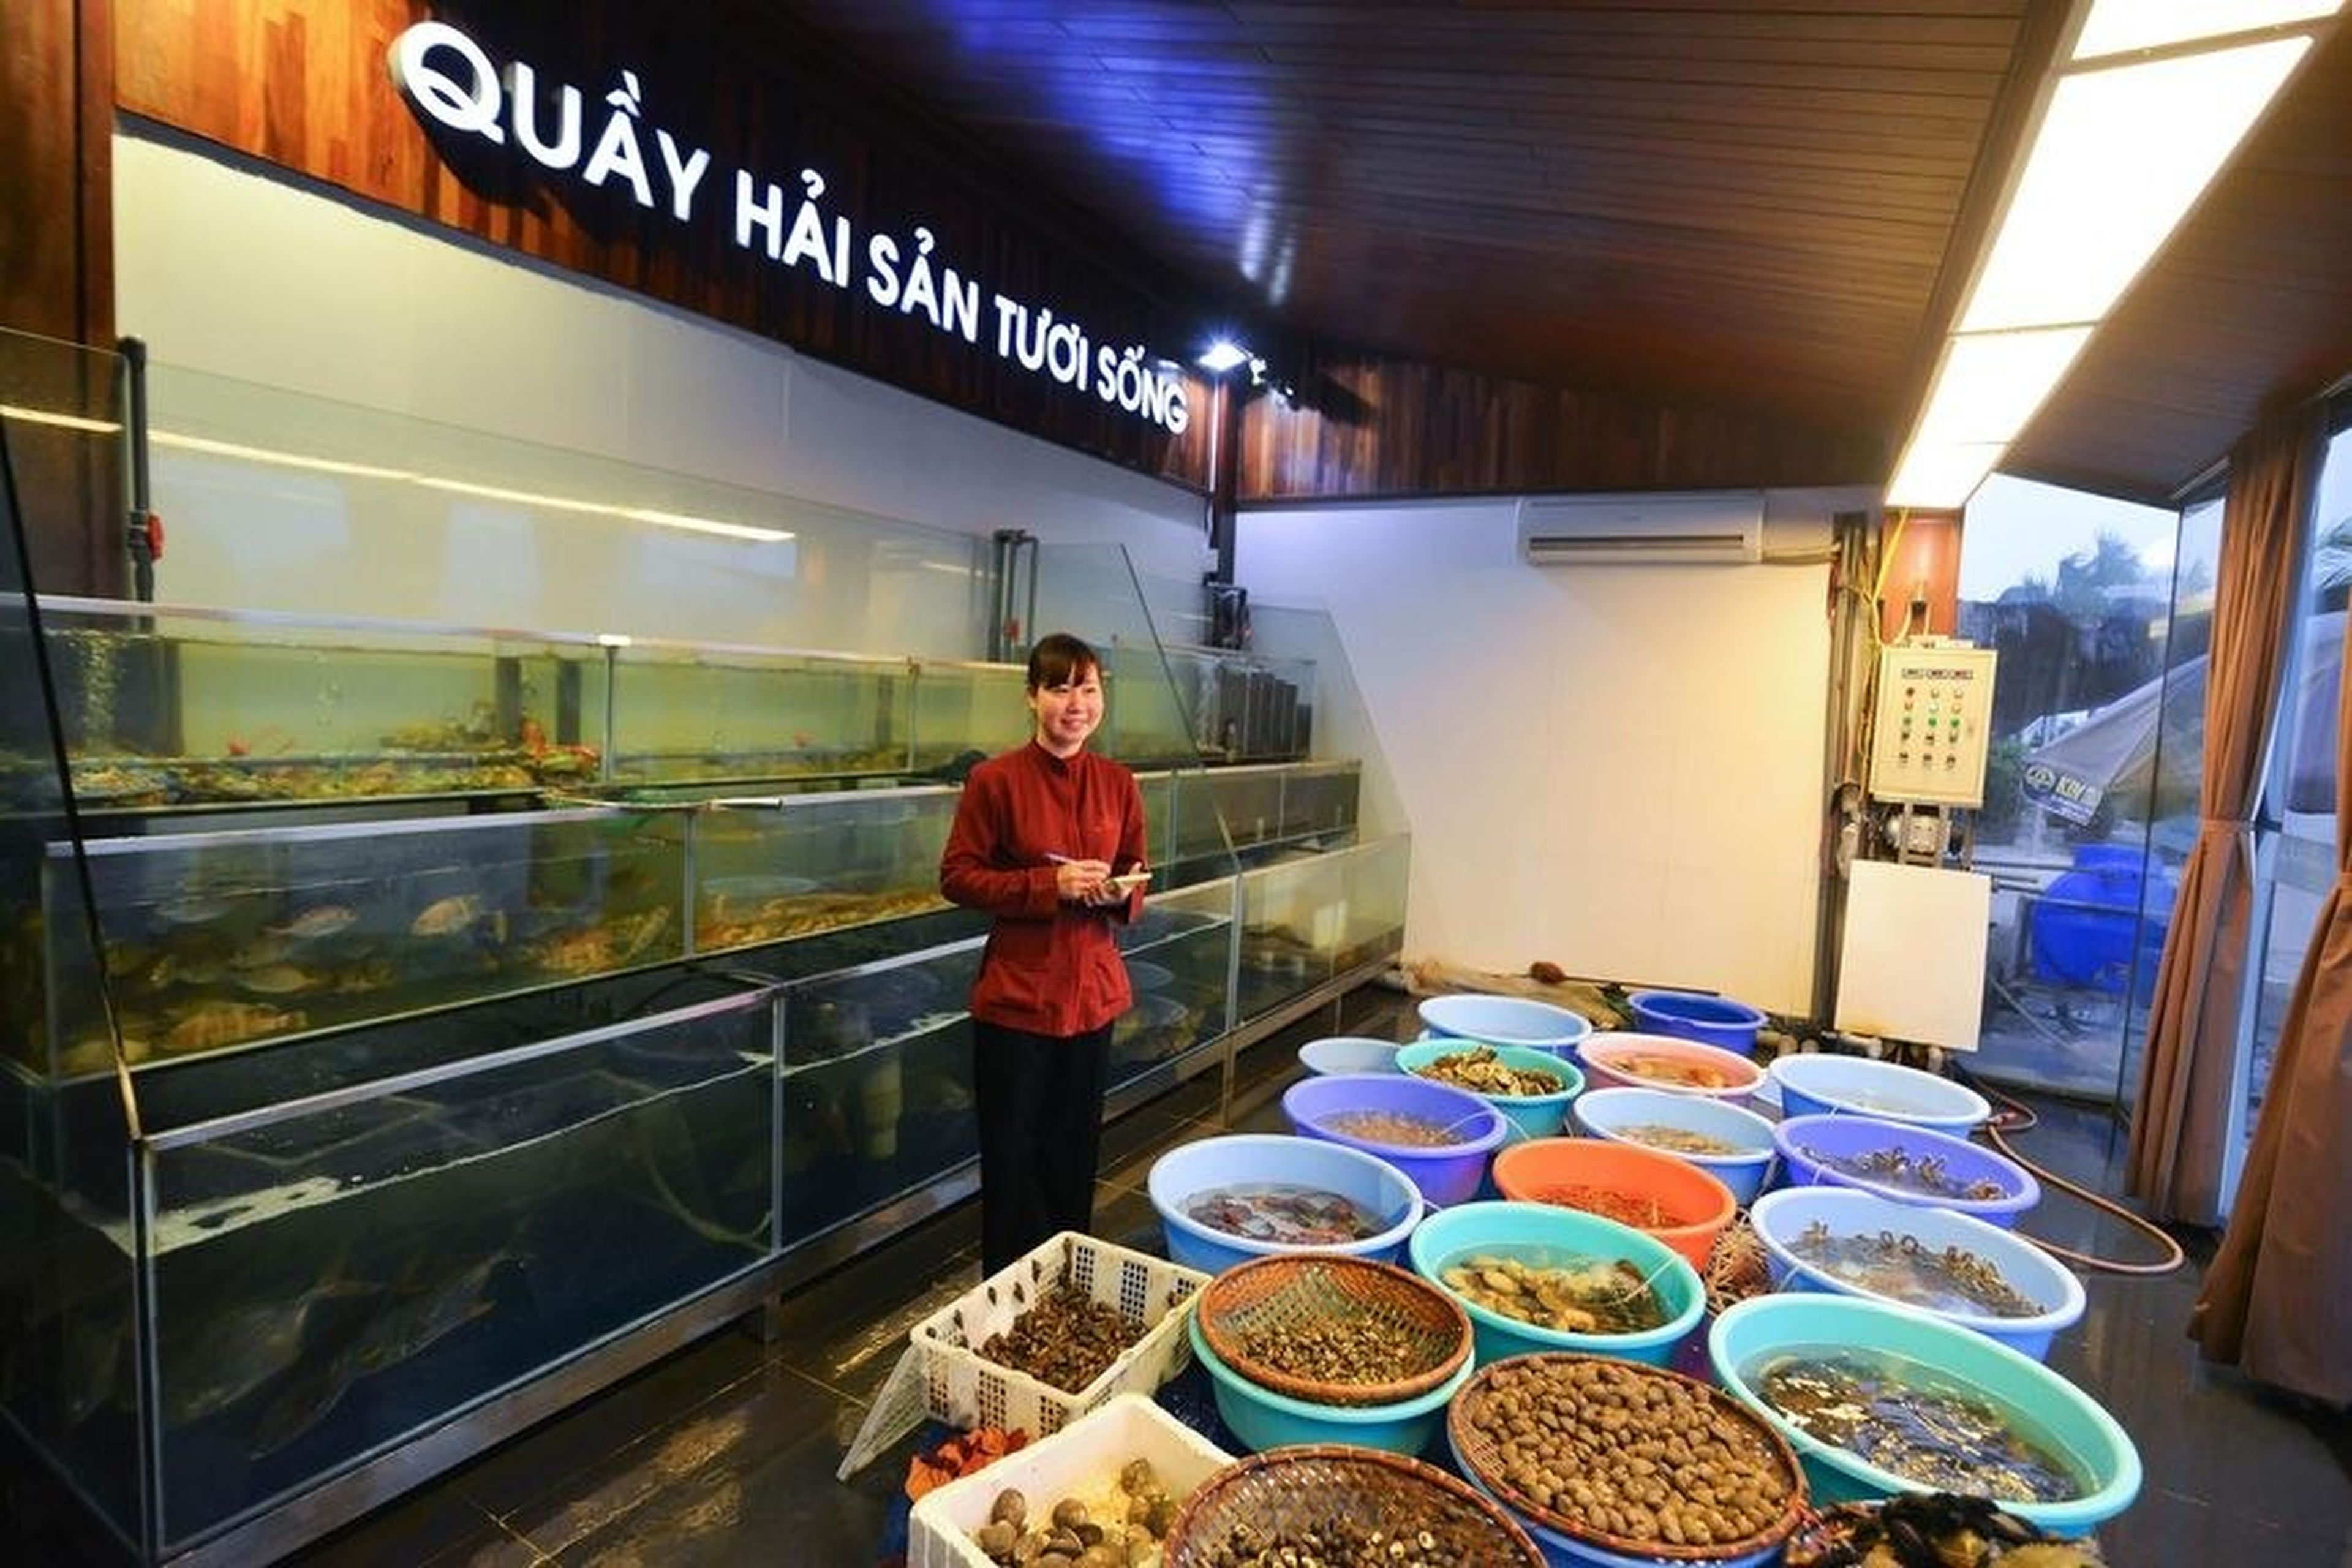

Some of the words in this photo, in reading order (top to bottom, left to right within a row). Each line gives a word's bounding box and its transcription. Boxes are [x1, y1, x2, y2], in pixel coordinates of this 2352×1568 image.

[388, 21, 710, 221] QUẦY
[737, 170, 850, 287] HẢI
[867, 227, 979, 342] SẢN
[995, 295, 1088, 391] TƯƠI
[1097, 345, 1188, 434] SỐNG
